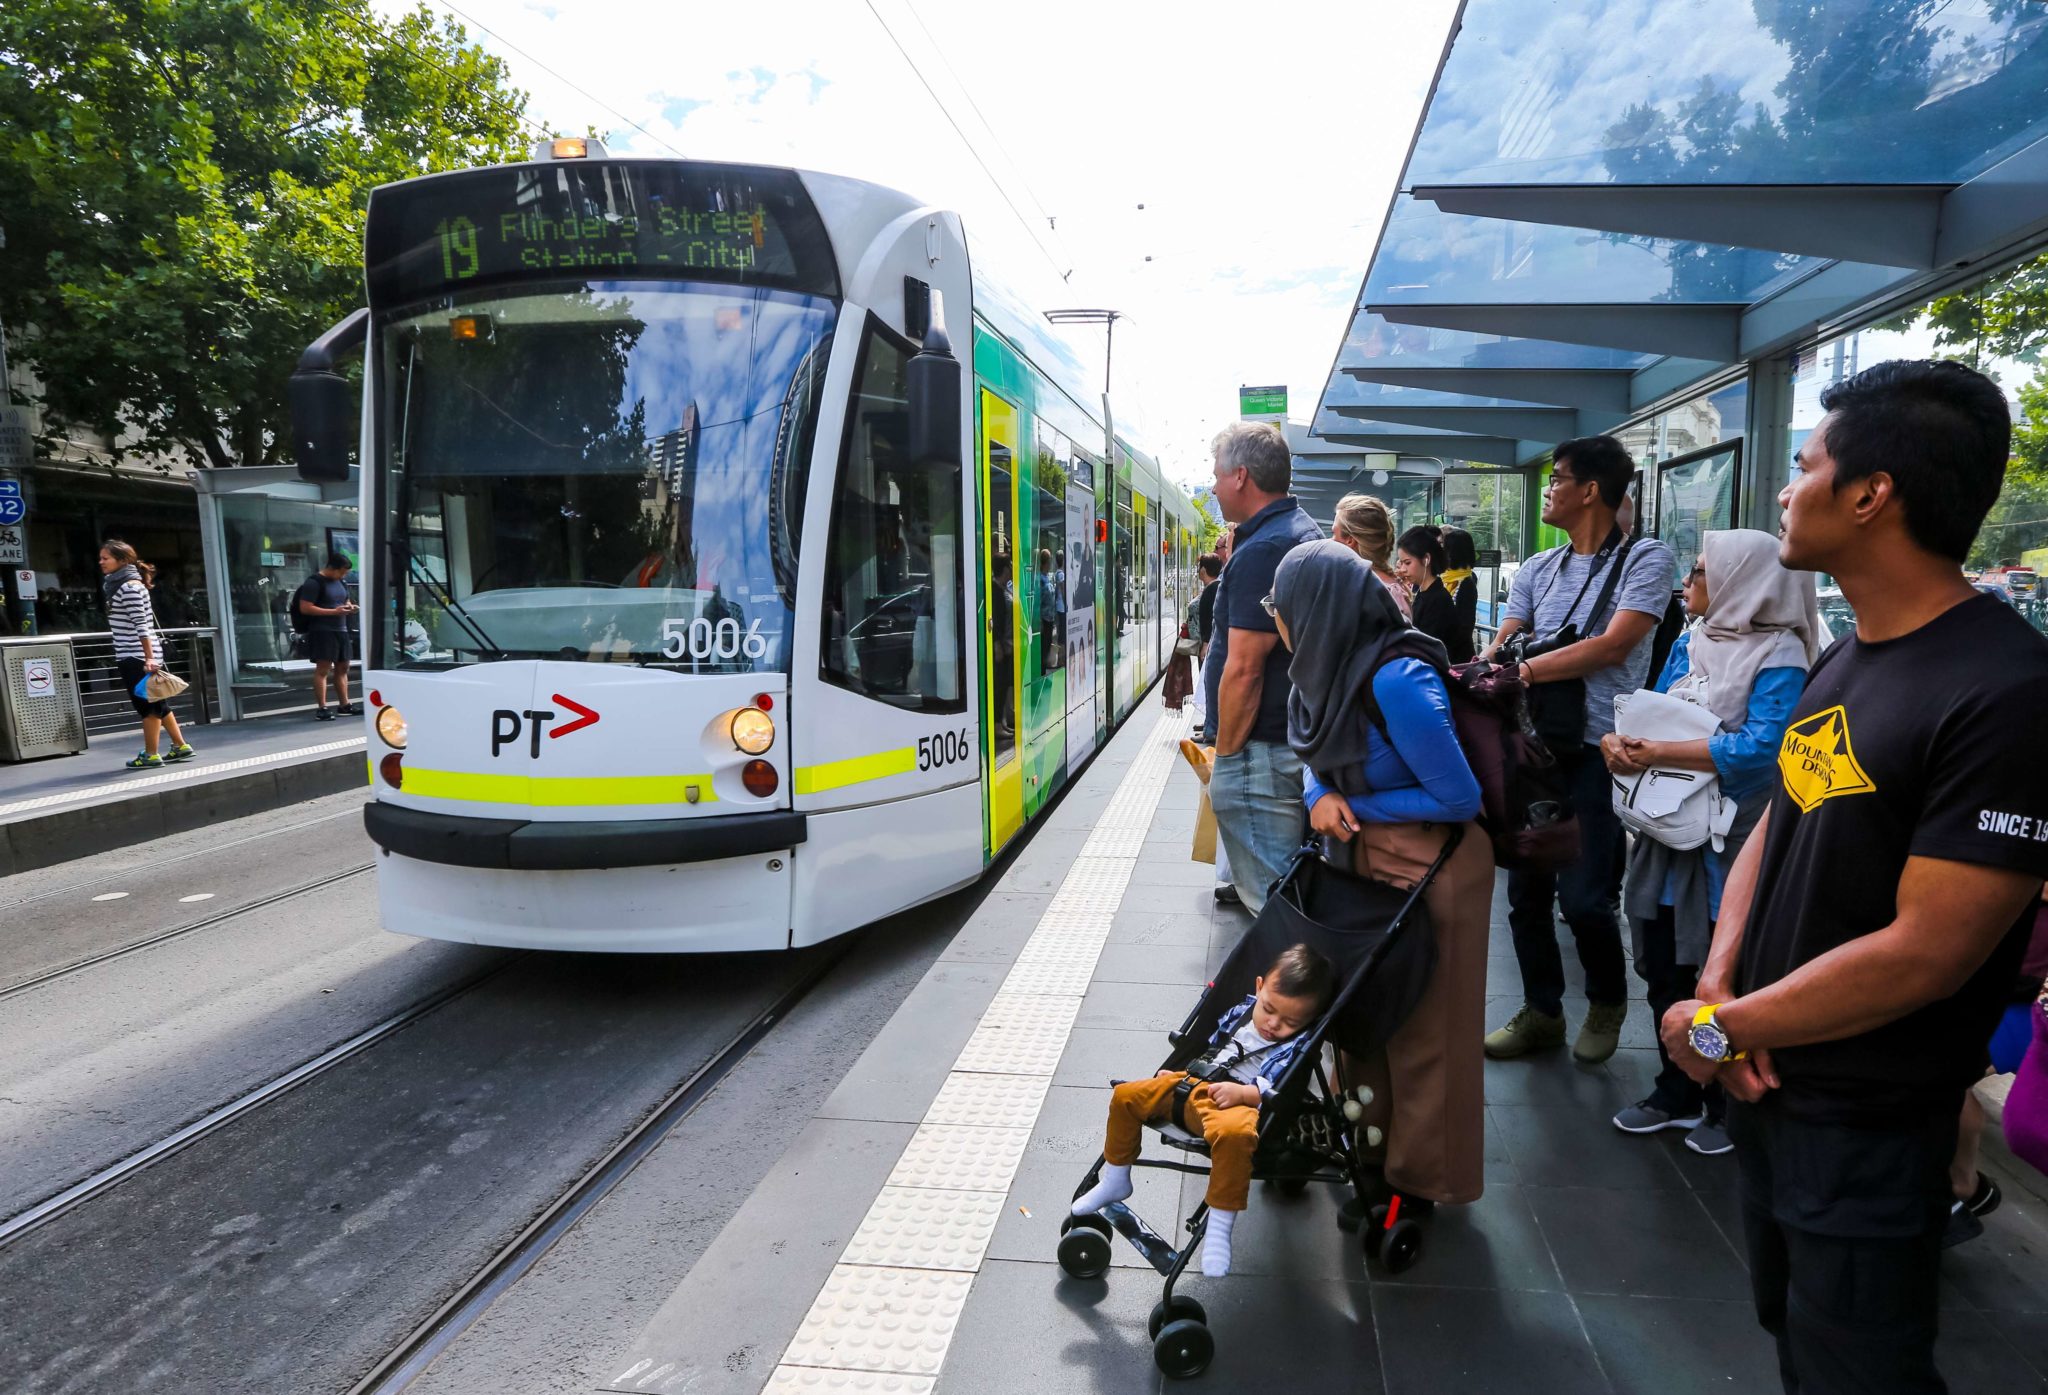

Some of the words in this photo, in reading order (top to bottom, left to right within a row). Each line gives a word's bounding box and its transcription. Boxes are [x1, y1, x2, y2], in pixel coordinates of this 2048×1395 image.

[435, 216, 479, 279] 19
[501, 211, 638, 243] Flinders
[658, 203, 768, 237] Street
[687, 240, 752, 268] City
[662, 617, 767, 659] 5006
[918, 728, 969, 772] 5006
[1978, 809, 2033, 838] SINCE
